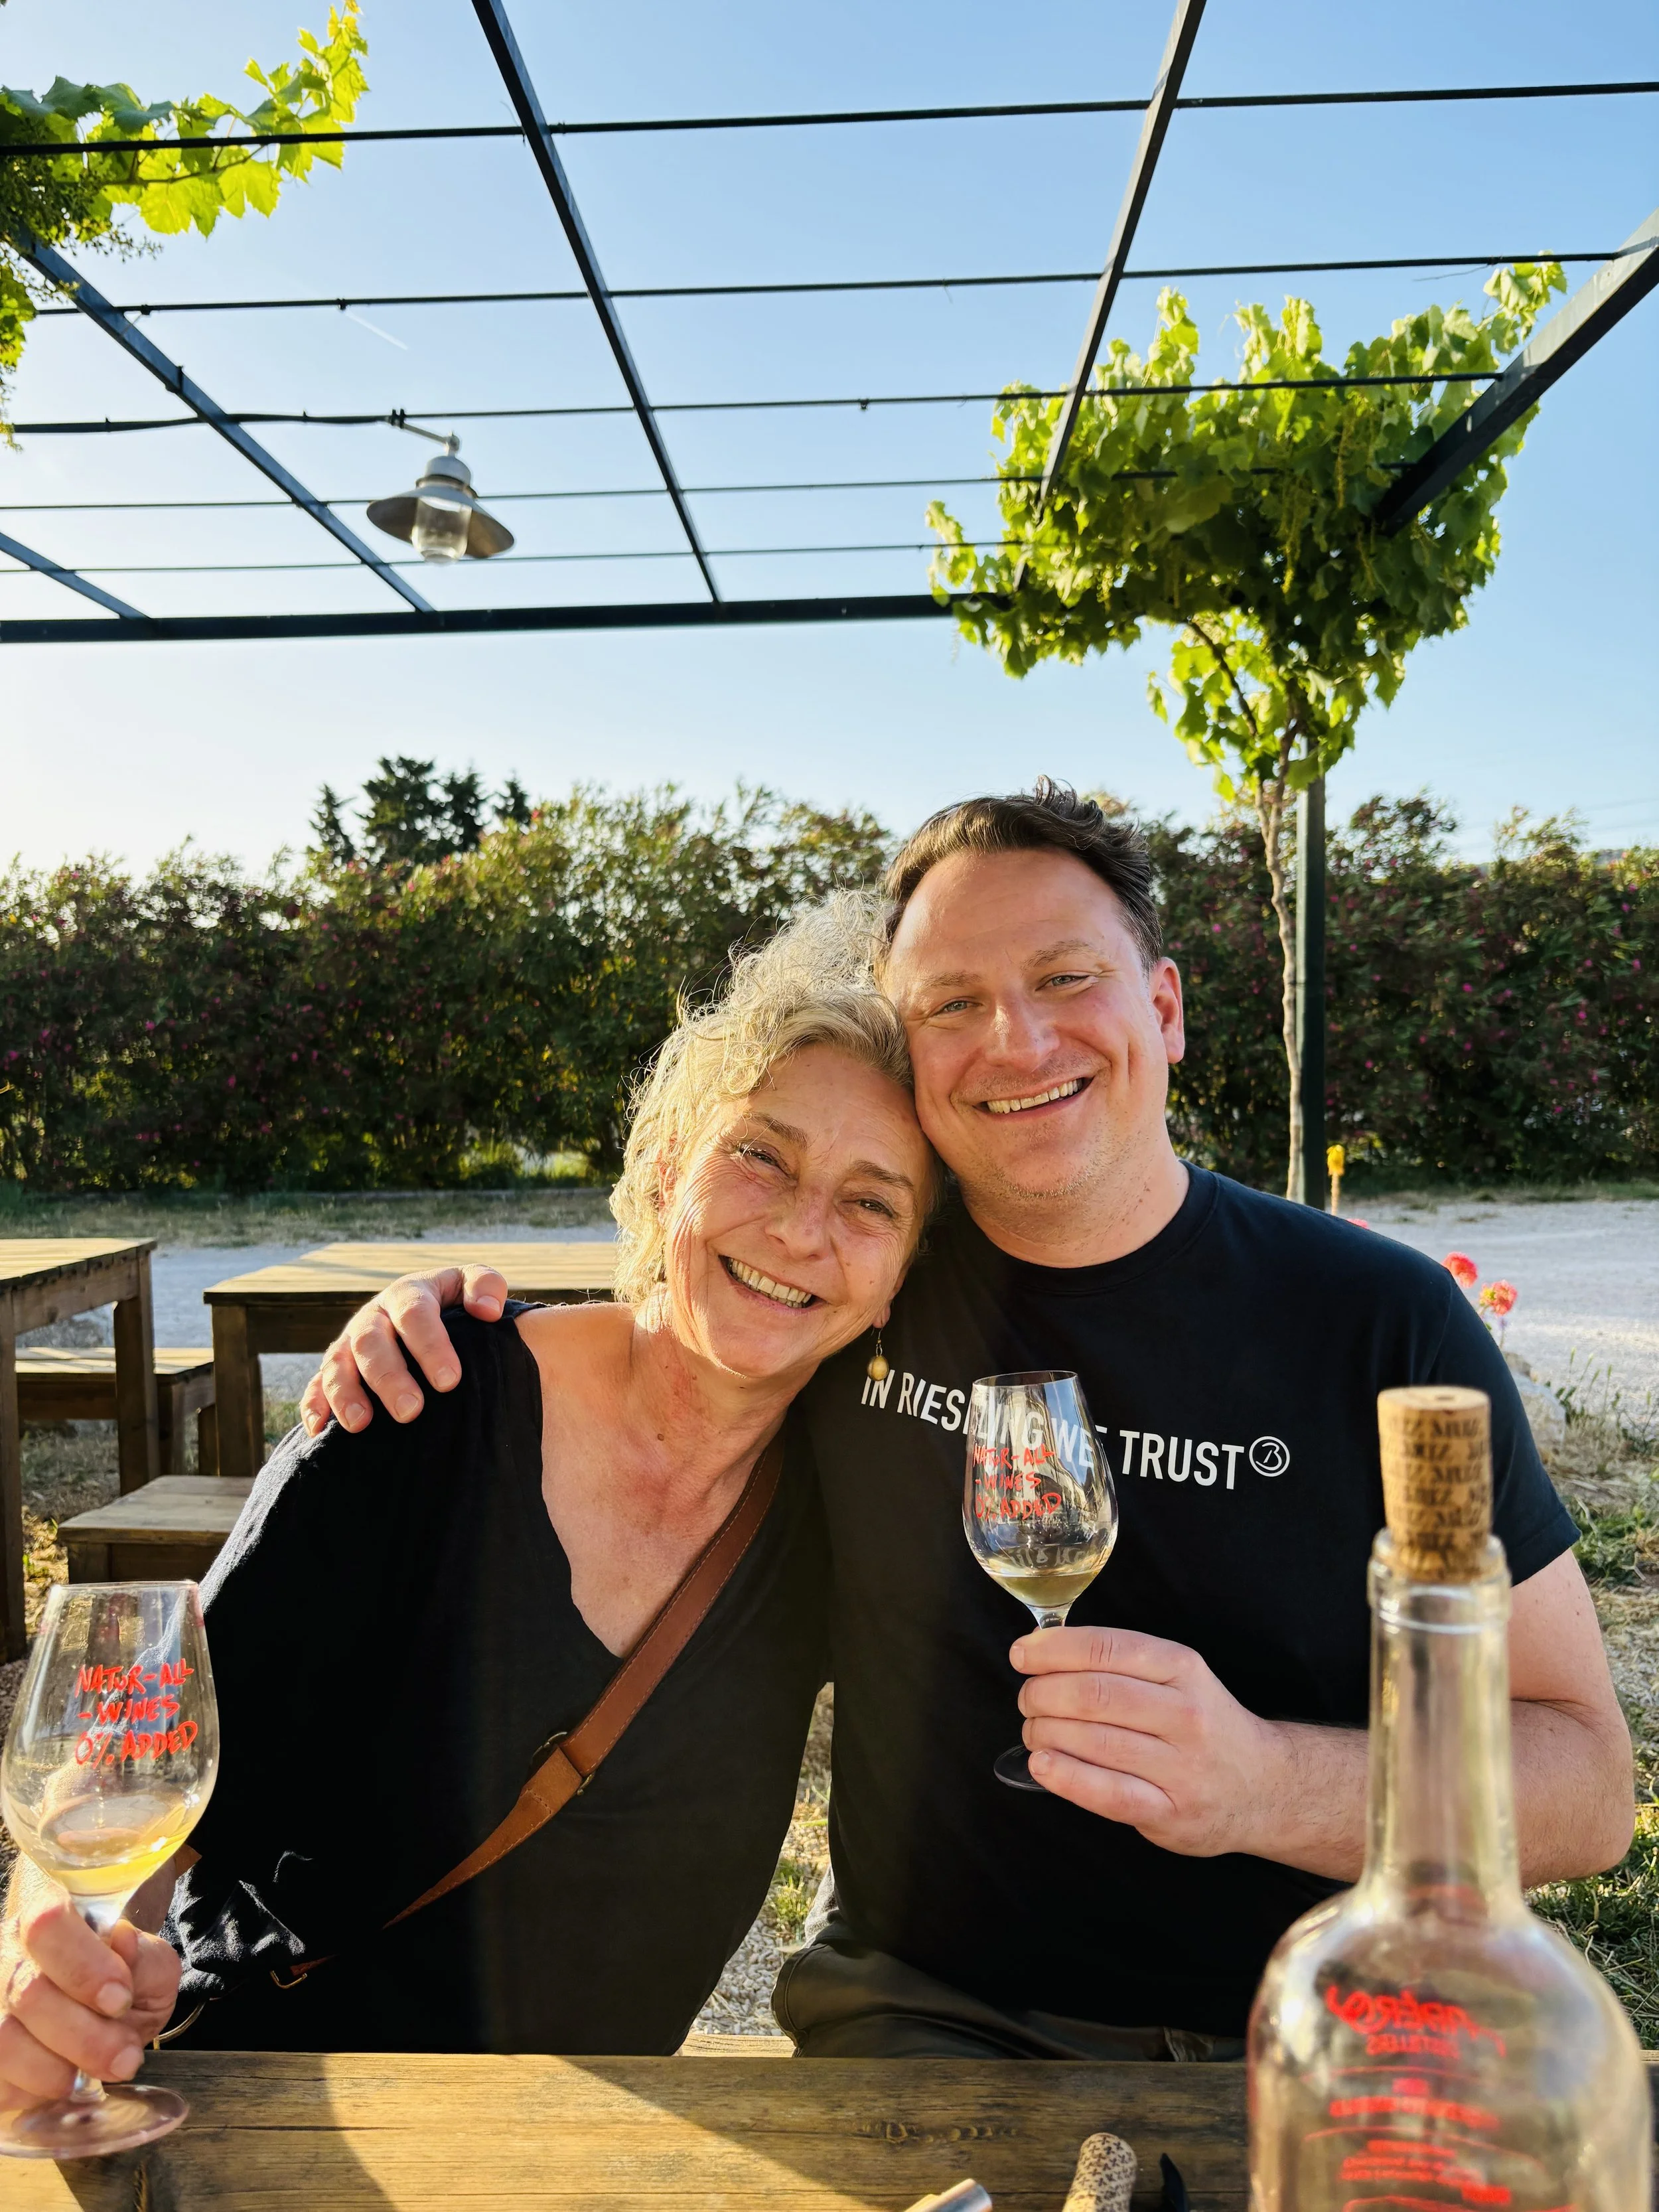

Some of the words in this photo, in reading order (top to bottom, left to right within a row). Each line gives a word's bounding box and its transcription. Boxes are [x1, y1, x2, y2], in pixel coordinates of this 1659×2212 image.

[861, 1369, 895, 1409] IN
[1050, 1418, 1108, 1468] WE
[1119, 1430, 1245, 1490] TRUST
[1000, 1492, 1062, 1520] ADDED
[120, 1720, 198, 1763] ADDED
